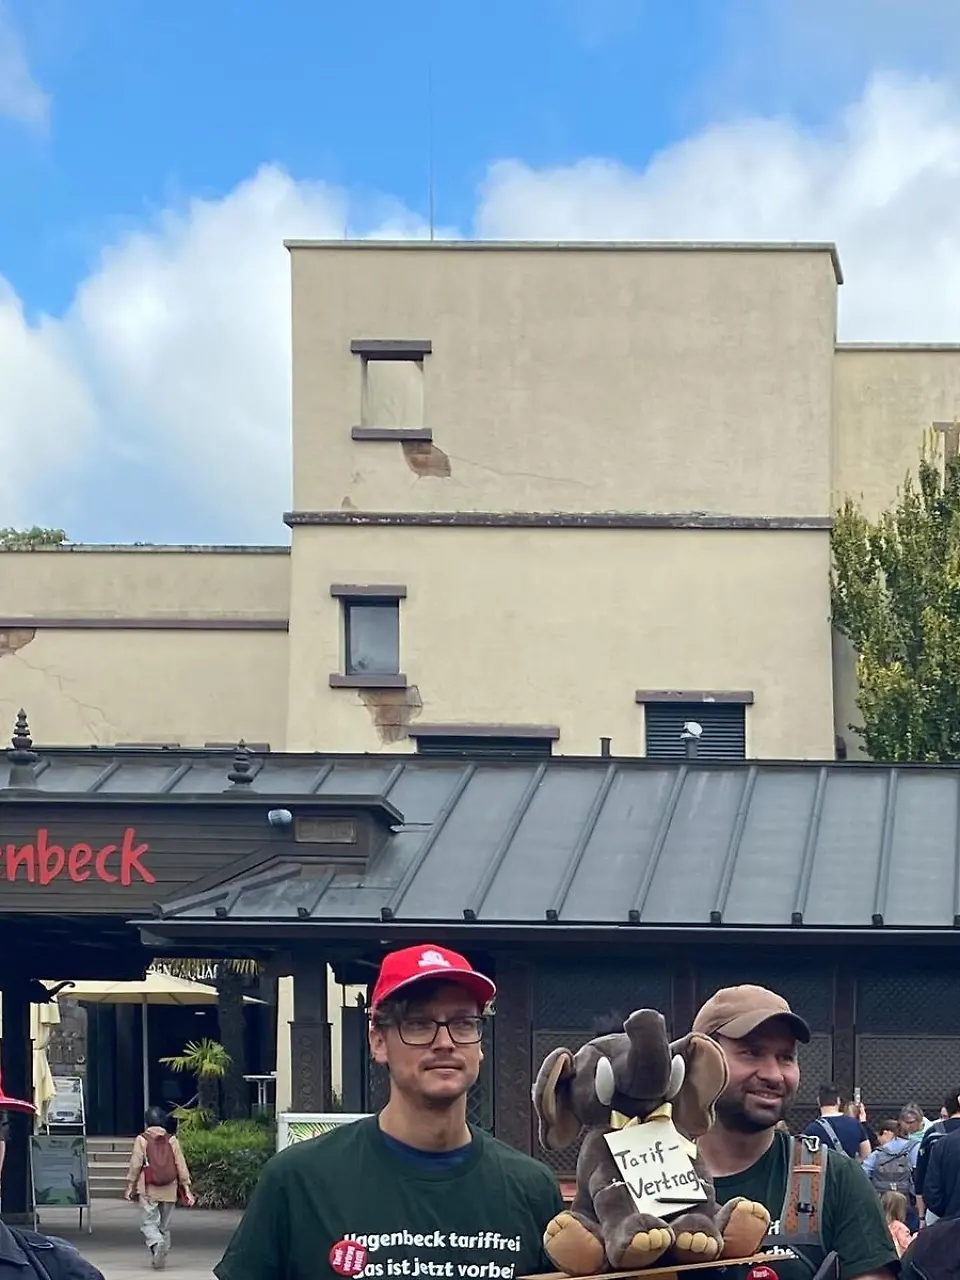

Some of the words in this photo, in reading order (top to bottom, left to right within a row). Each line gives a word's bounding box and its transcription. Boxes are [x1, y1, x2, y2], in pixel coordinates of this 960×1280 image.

[0, 828, 156, 885] nbeck
[614, 1141, 679, 1170] Tarif-
[627, 1169, 700, 1199] Vertrag
[449, 1231, 521, 1252] tariffrei
[352, 1264, 384, 1280] as
[387, 1258, 410, 1276] ist
[411, 1257, 454, 1277] jetzt
[457, 1263, 515, 1280] vorbei
